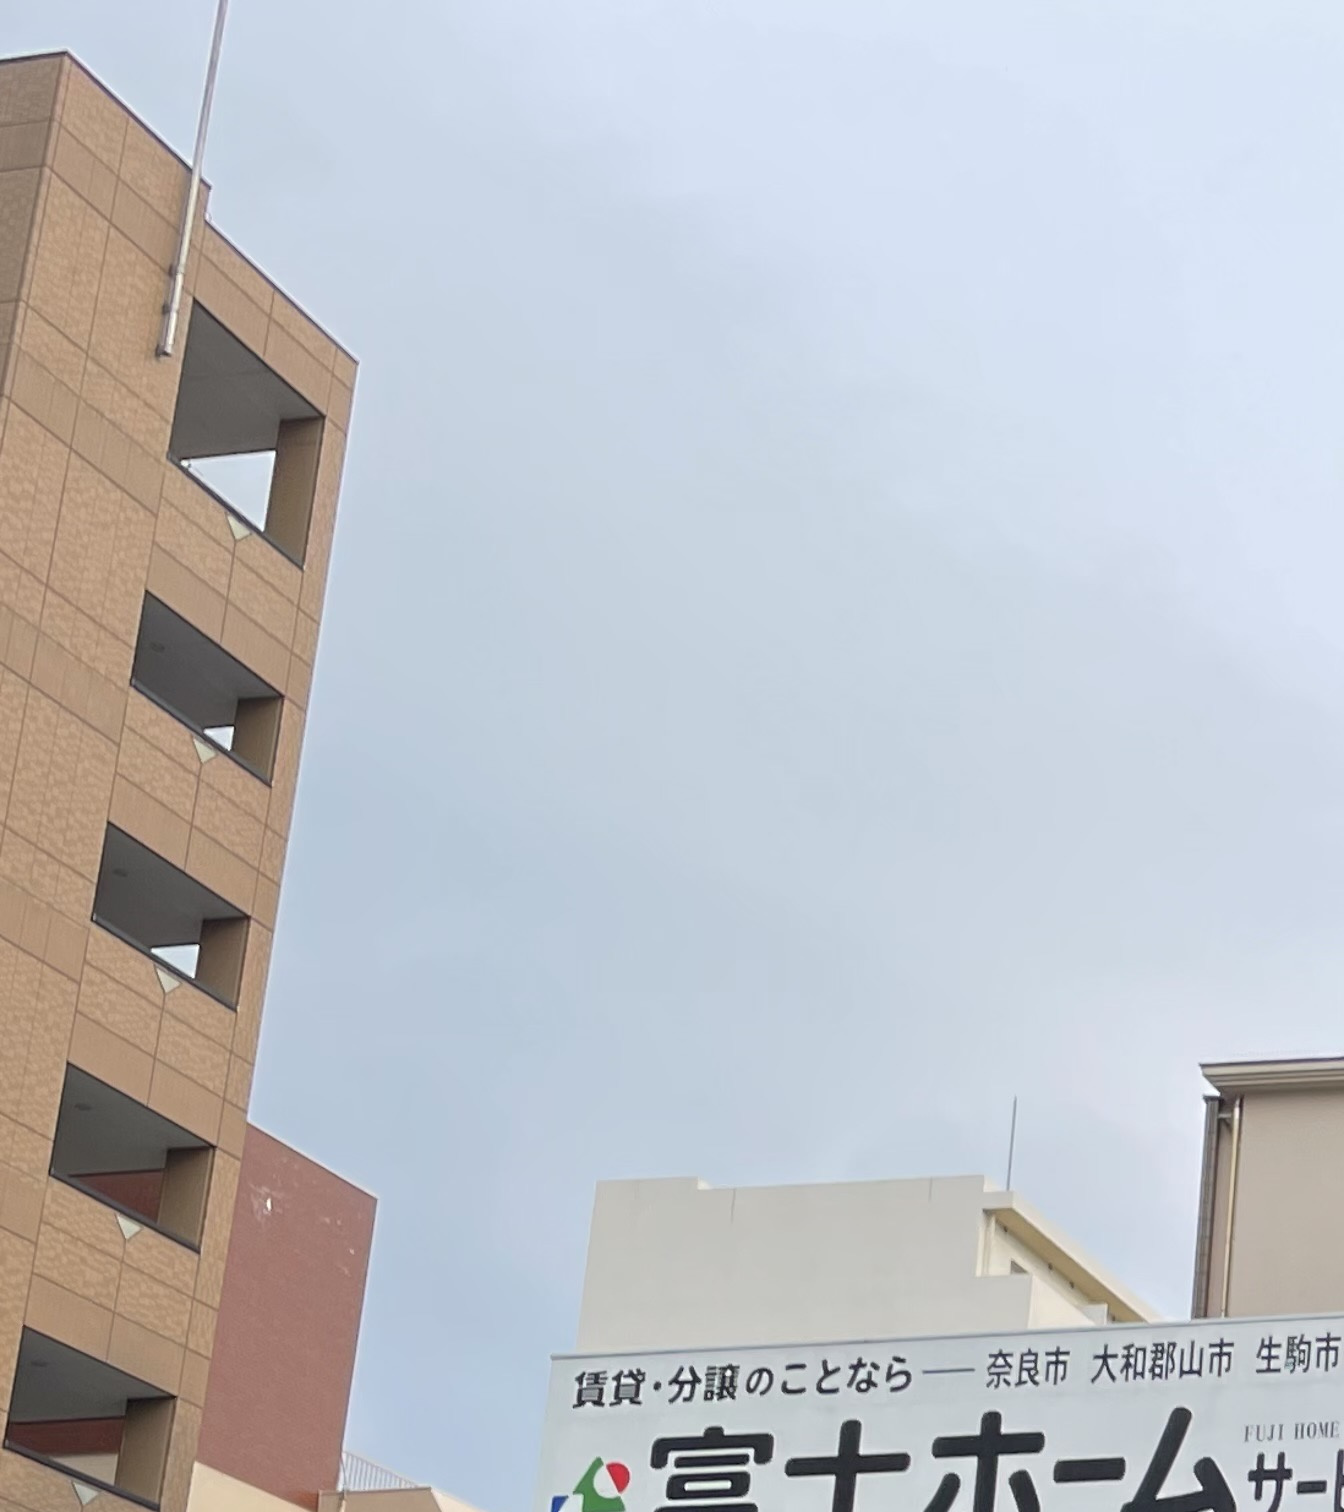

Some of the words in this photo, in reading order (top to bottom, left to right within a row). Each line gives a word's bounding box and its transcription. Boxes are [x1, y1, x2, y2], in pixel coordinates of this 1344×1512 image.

[985, 1345, 1071, 1390] 奈良市
[1091, 1337, 1235, 1384] 大和郡山市
[1256, 1332, 1342, 1375] 生駒市
[1244, 1424, 1285, 1443] FUJI
[1294, 1420, 1340, 1440] HOME
